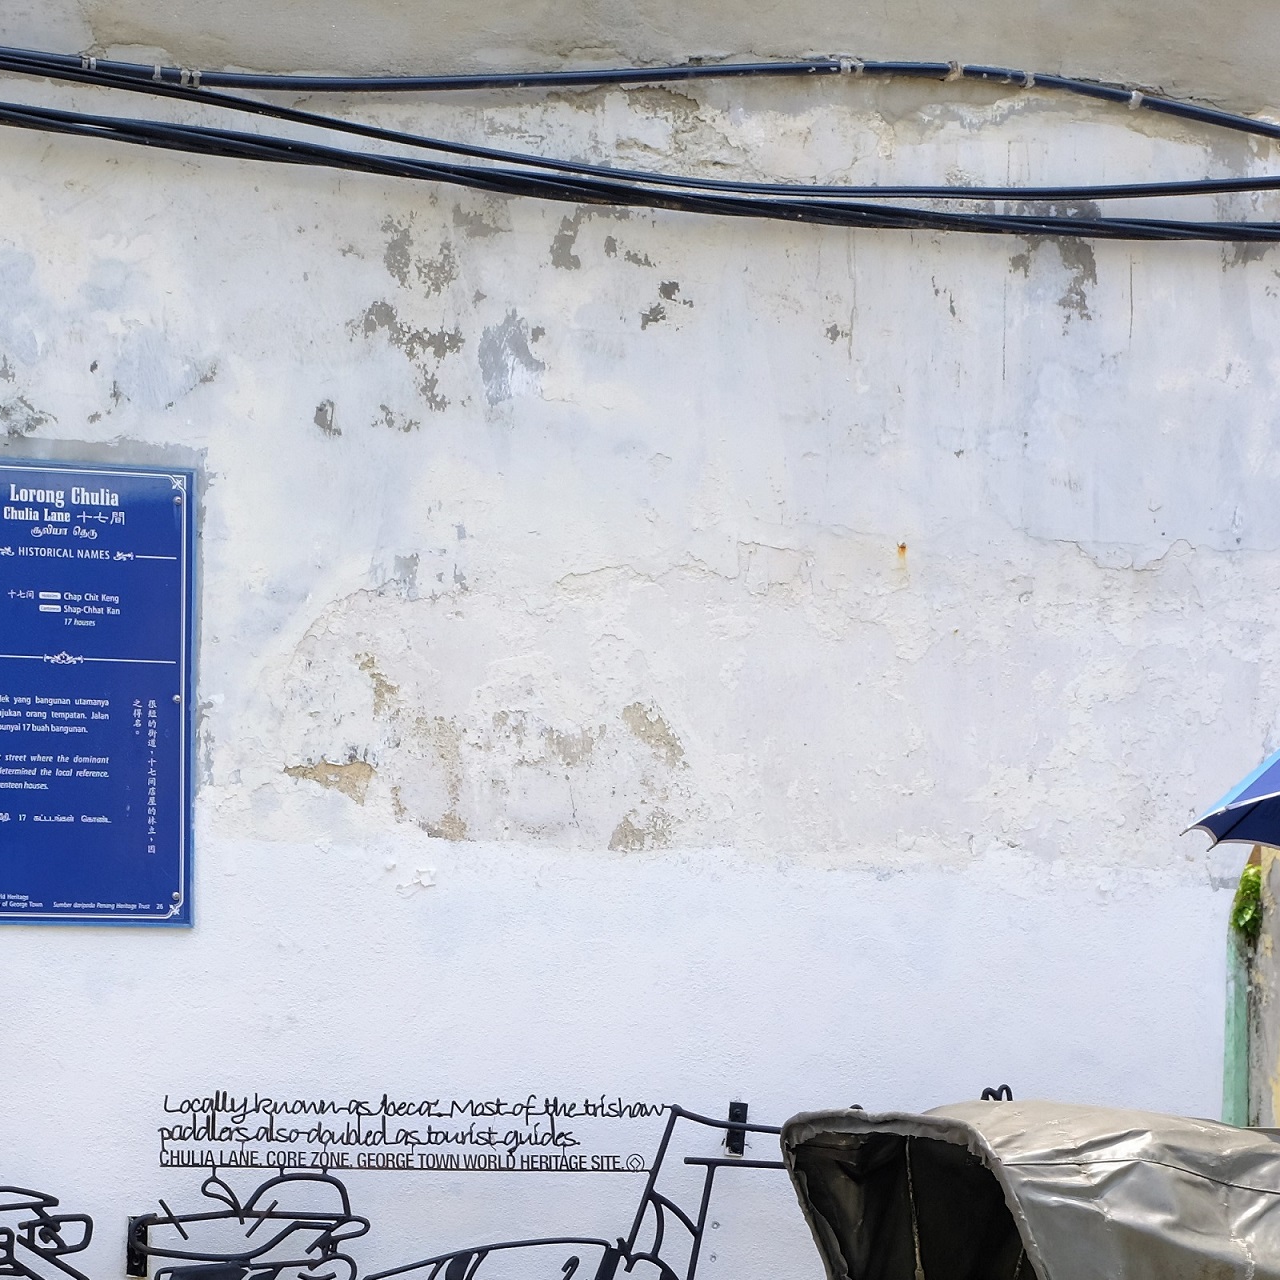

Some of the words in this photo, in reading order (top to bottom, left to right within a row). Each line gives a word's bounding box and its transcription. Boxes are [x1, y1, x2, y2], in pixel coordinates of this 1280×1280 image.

[10, 484, 65, 508] Lorong
[71, 487, 119, 506] Chulia
[3, 507, 39, 521] Chulia
[44, 508, 71, 522] Lane
[77, 511, 125, 525] 十七間
[18, 547, 74, 558] HISTORICAL
[77, 549, 110, 559] NAMES
[63, 592, 82, 602] Chap
[84, 593, 99, 601] Chit
[101, 594, 119, 604] Keng
[63, 605, 104, 614] Shap-Chhat
[74, 618, 96, 626] houses
[13, 696, 31, 705] yang
[35, 696, 70, 706] bangunan
[74, 697, 109, 708] utamanya
[25, 711, 47, 719] orang
[51, 711, 87, 720] tempatan.
[91, 711, 109, 720] Jalan
[31, 724, 49, 732] buah
[50, 724, 88, 734] bangunan.
[30, 754, 53, 762] where
[57, 754, 69, 762] the
[73, 755, 109, 764] dominant
[40, 768, 52, 776] the
[55, 768, 72, 776] local
[76, 769, 109, 777] reference.
[24, 781, 49, 789] houses.
[163, 1090, 248, 1123] Locally
[255, 1092, 334, 1115] known
[348, 1099, 371, 1116] as
[451, 1099, 504, 1118] Most
[514, 1094, 537, 1126] of
[544, 1096, 575, 1118] the
[584, 1094, 666, 1118] trishaw
[158, 1112, 249, 1150] paddlers
[256, 1114, 300, 1143] also
[307, 1114, 387, 1146] doubled
[396, 1129, 419, 1146] as
[428, 1122, 498, 1146] tourist
[504, 1122, 581, 1153] guides.
[159, 1150, 215, 1167] CHULIA
[266, 1151, 307, 1167] CORE
[357, 1152, 414, 1168] GEORGE
[419, 1153, 460, 1169] TOWN
[463, 1153, 516, 1169] WORLD
[521, 1154, 587, 1170] HERITAGE
